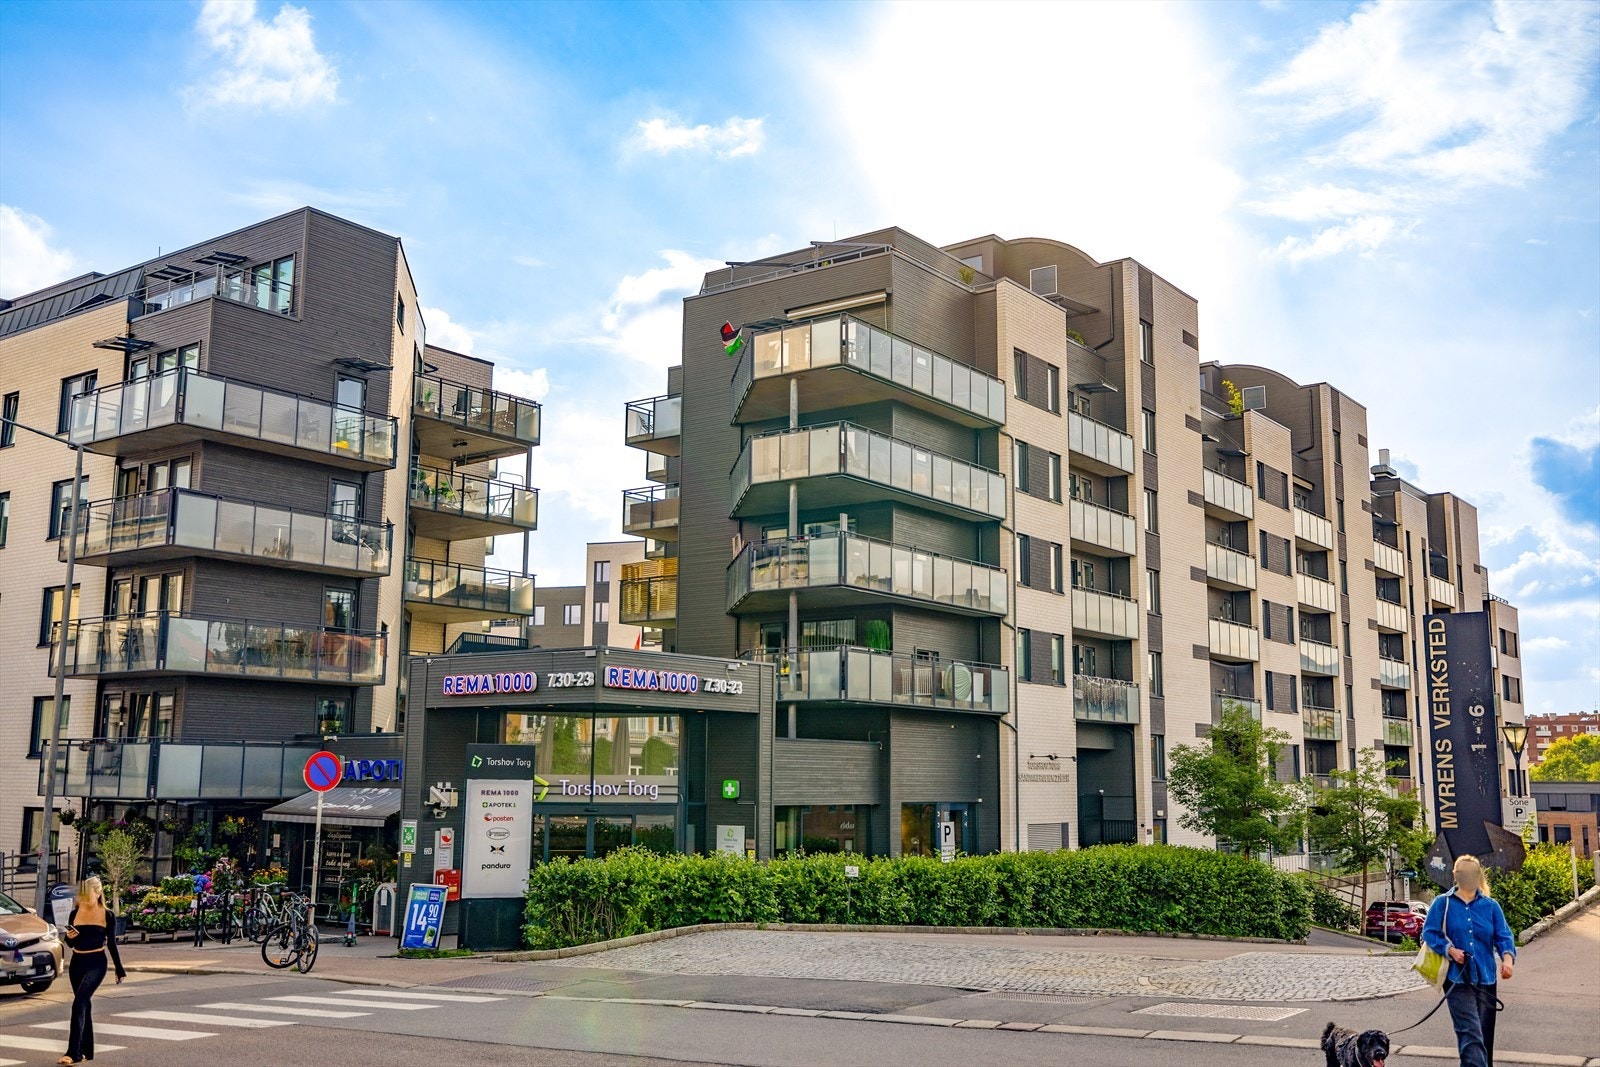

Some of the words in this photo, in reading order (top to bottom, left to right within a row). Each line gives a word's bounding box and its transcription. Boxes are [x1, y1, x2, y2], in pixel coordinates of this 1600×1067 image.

[443, 676, 490, 695] REMA
[493, 673, 536, 691] 1000
[608, 667, 659, 690] REMA
[660, 672, 699, 693] 1000
[1428, 617, 1451, 730] VERKSTED
[486, 757, 514, 766] Torshov
[516, 757, 531, 768] Torg
[559, 779, 622, 797] Torshov
[625, 779, 659, 800] Torg
[1434, 738, 1458, 830] MYRENS
[492, 815, 514, 823] posten
[1515, 808, 1523, 817] P
[944, 825, 951, 842] P
[481, 862, 511, 871] panduro
[410, 903, 427, 931] 14
[428, 904, 439, 918] 90
